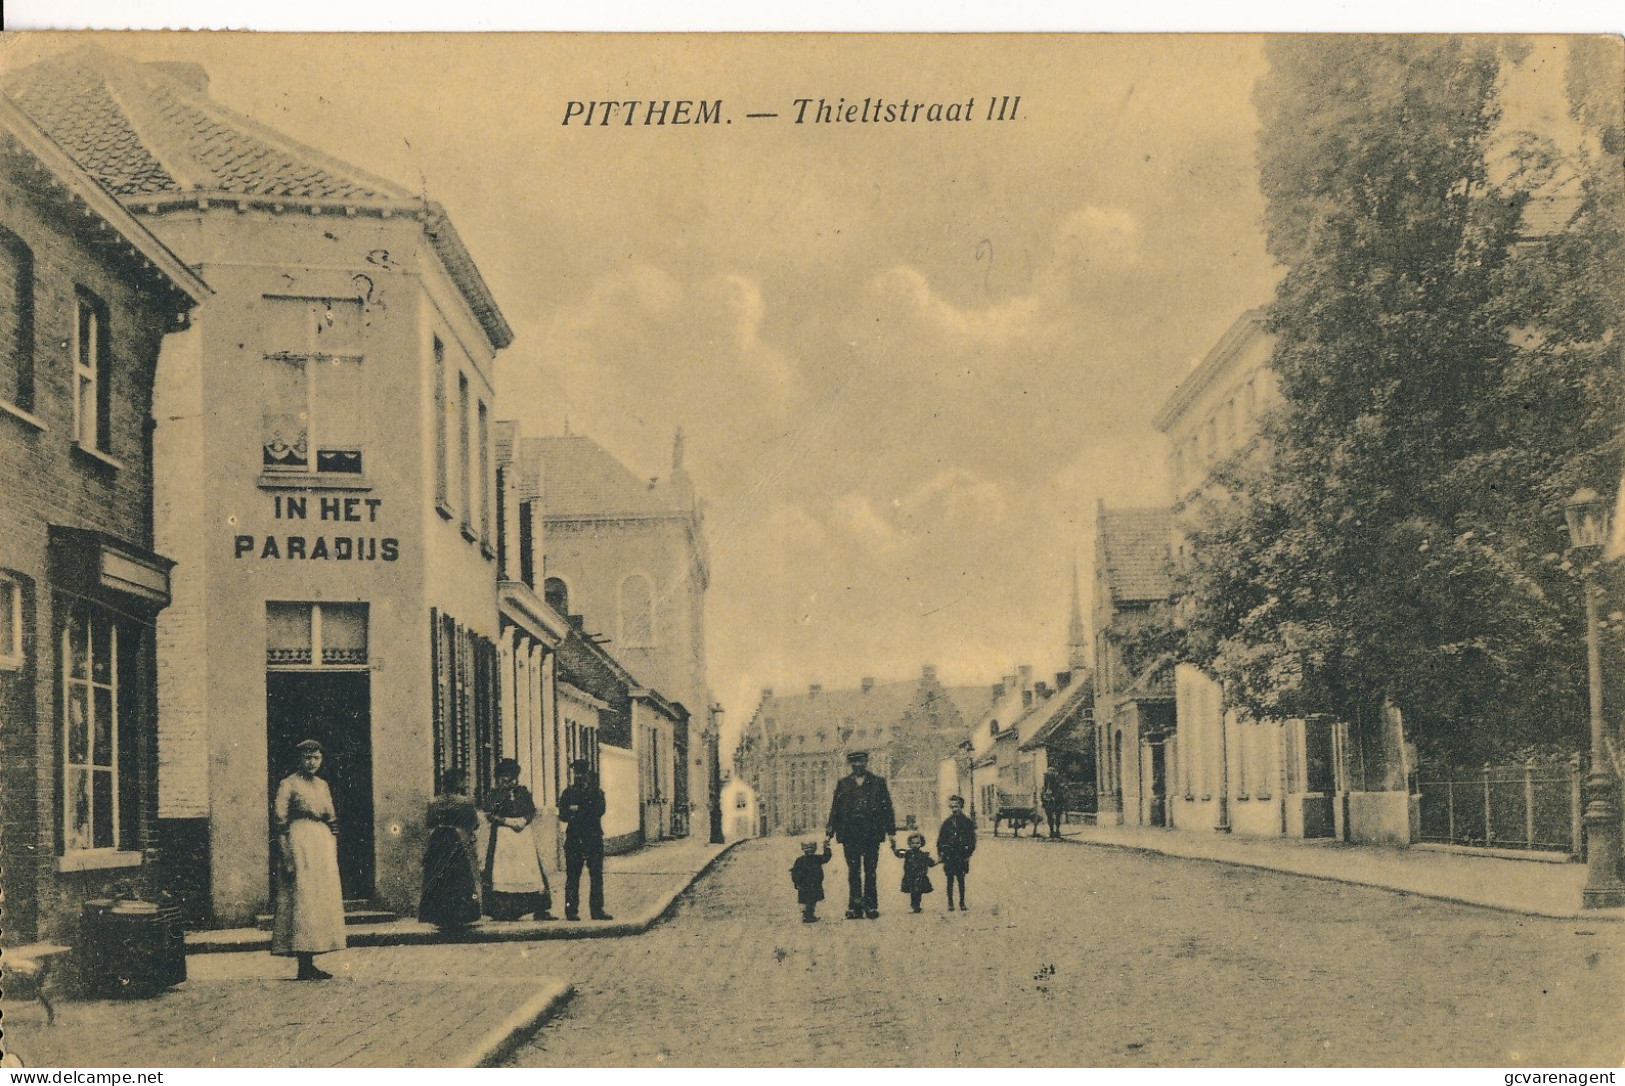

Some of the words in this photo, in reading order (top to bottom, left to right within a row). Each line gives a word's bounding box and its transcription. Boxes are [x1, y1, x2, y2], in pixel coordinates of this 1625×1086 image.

[274, 496, 307, 519] IN
[320, 497, 382, 522] HET
[234, 535, 399, 562] PARADIJS
